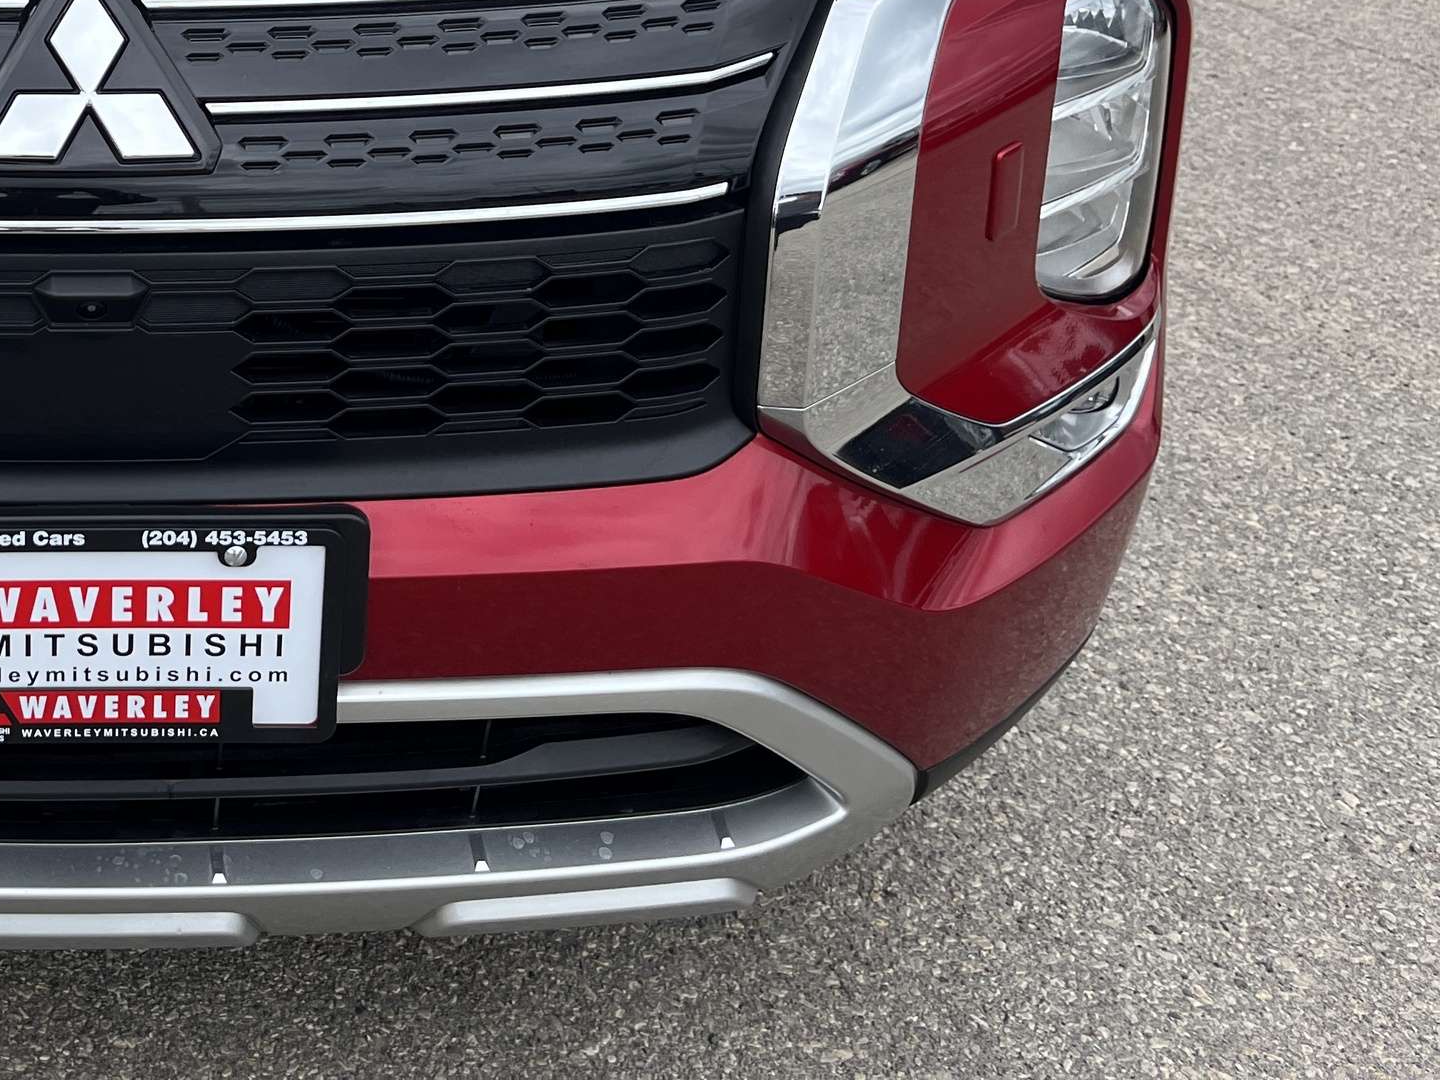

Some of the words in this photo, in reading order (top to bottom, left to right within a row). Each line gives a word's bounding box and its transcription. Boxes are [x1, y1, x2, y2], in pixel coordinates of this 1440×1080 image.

[32, 530, 86, 547] Cars
[141, 530, 198, 549] (204)
[205, 530, 308, 546] 453-5453
[18, 694, 216, 719] WAVERLEY
[21, 727, 220, 738] WAVERLEYMITSUBISHI.CA
